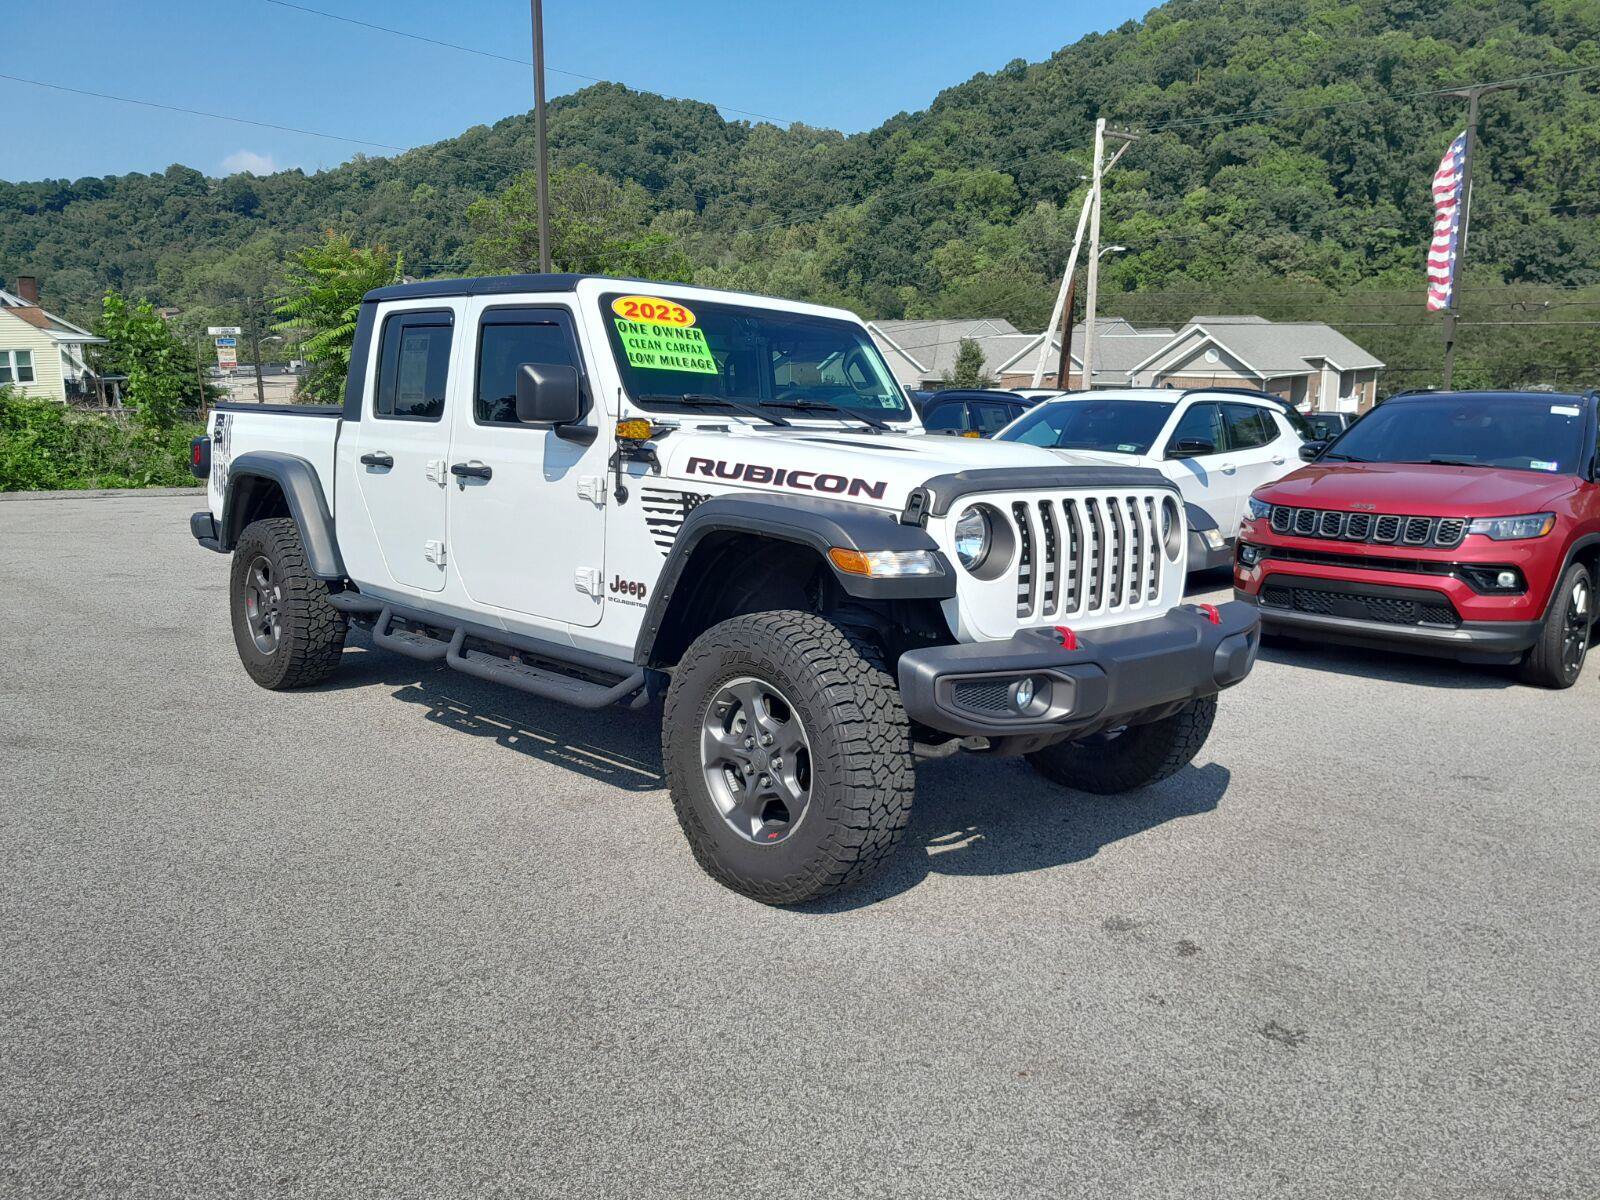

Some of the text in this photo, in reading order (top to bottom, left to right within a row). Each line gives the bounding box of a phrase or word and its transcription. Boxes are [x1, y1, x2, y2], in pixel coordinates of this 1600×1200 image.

[623, 301, 687, 323] 2023
[617, 321, 703, 341] ONE OWNER
[628, 338, 703, 355] CLEAN CARFAX
[628, 352, 714, 370] LOW MILEAGE
[685, 456, 889, 500] RUBICON
[609, 574, 647, 600] Jeep
